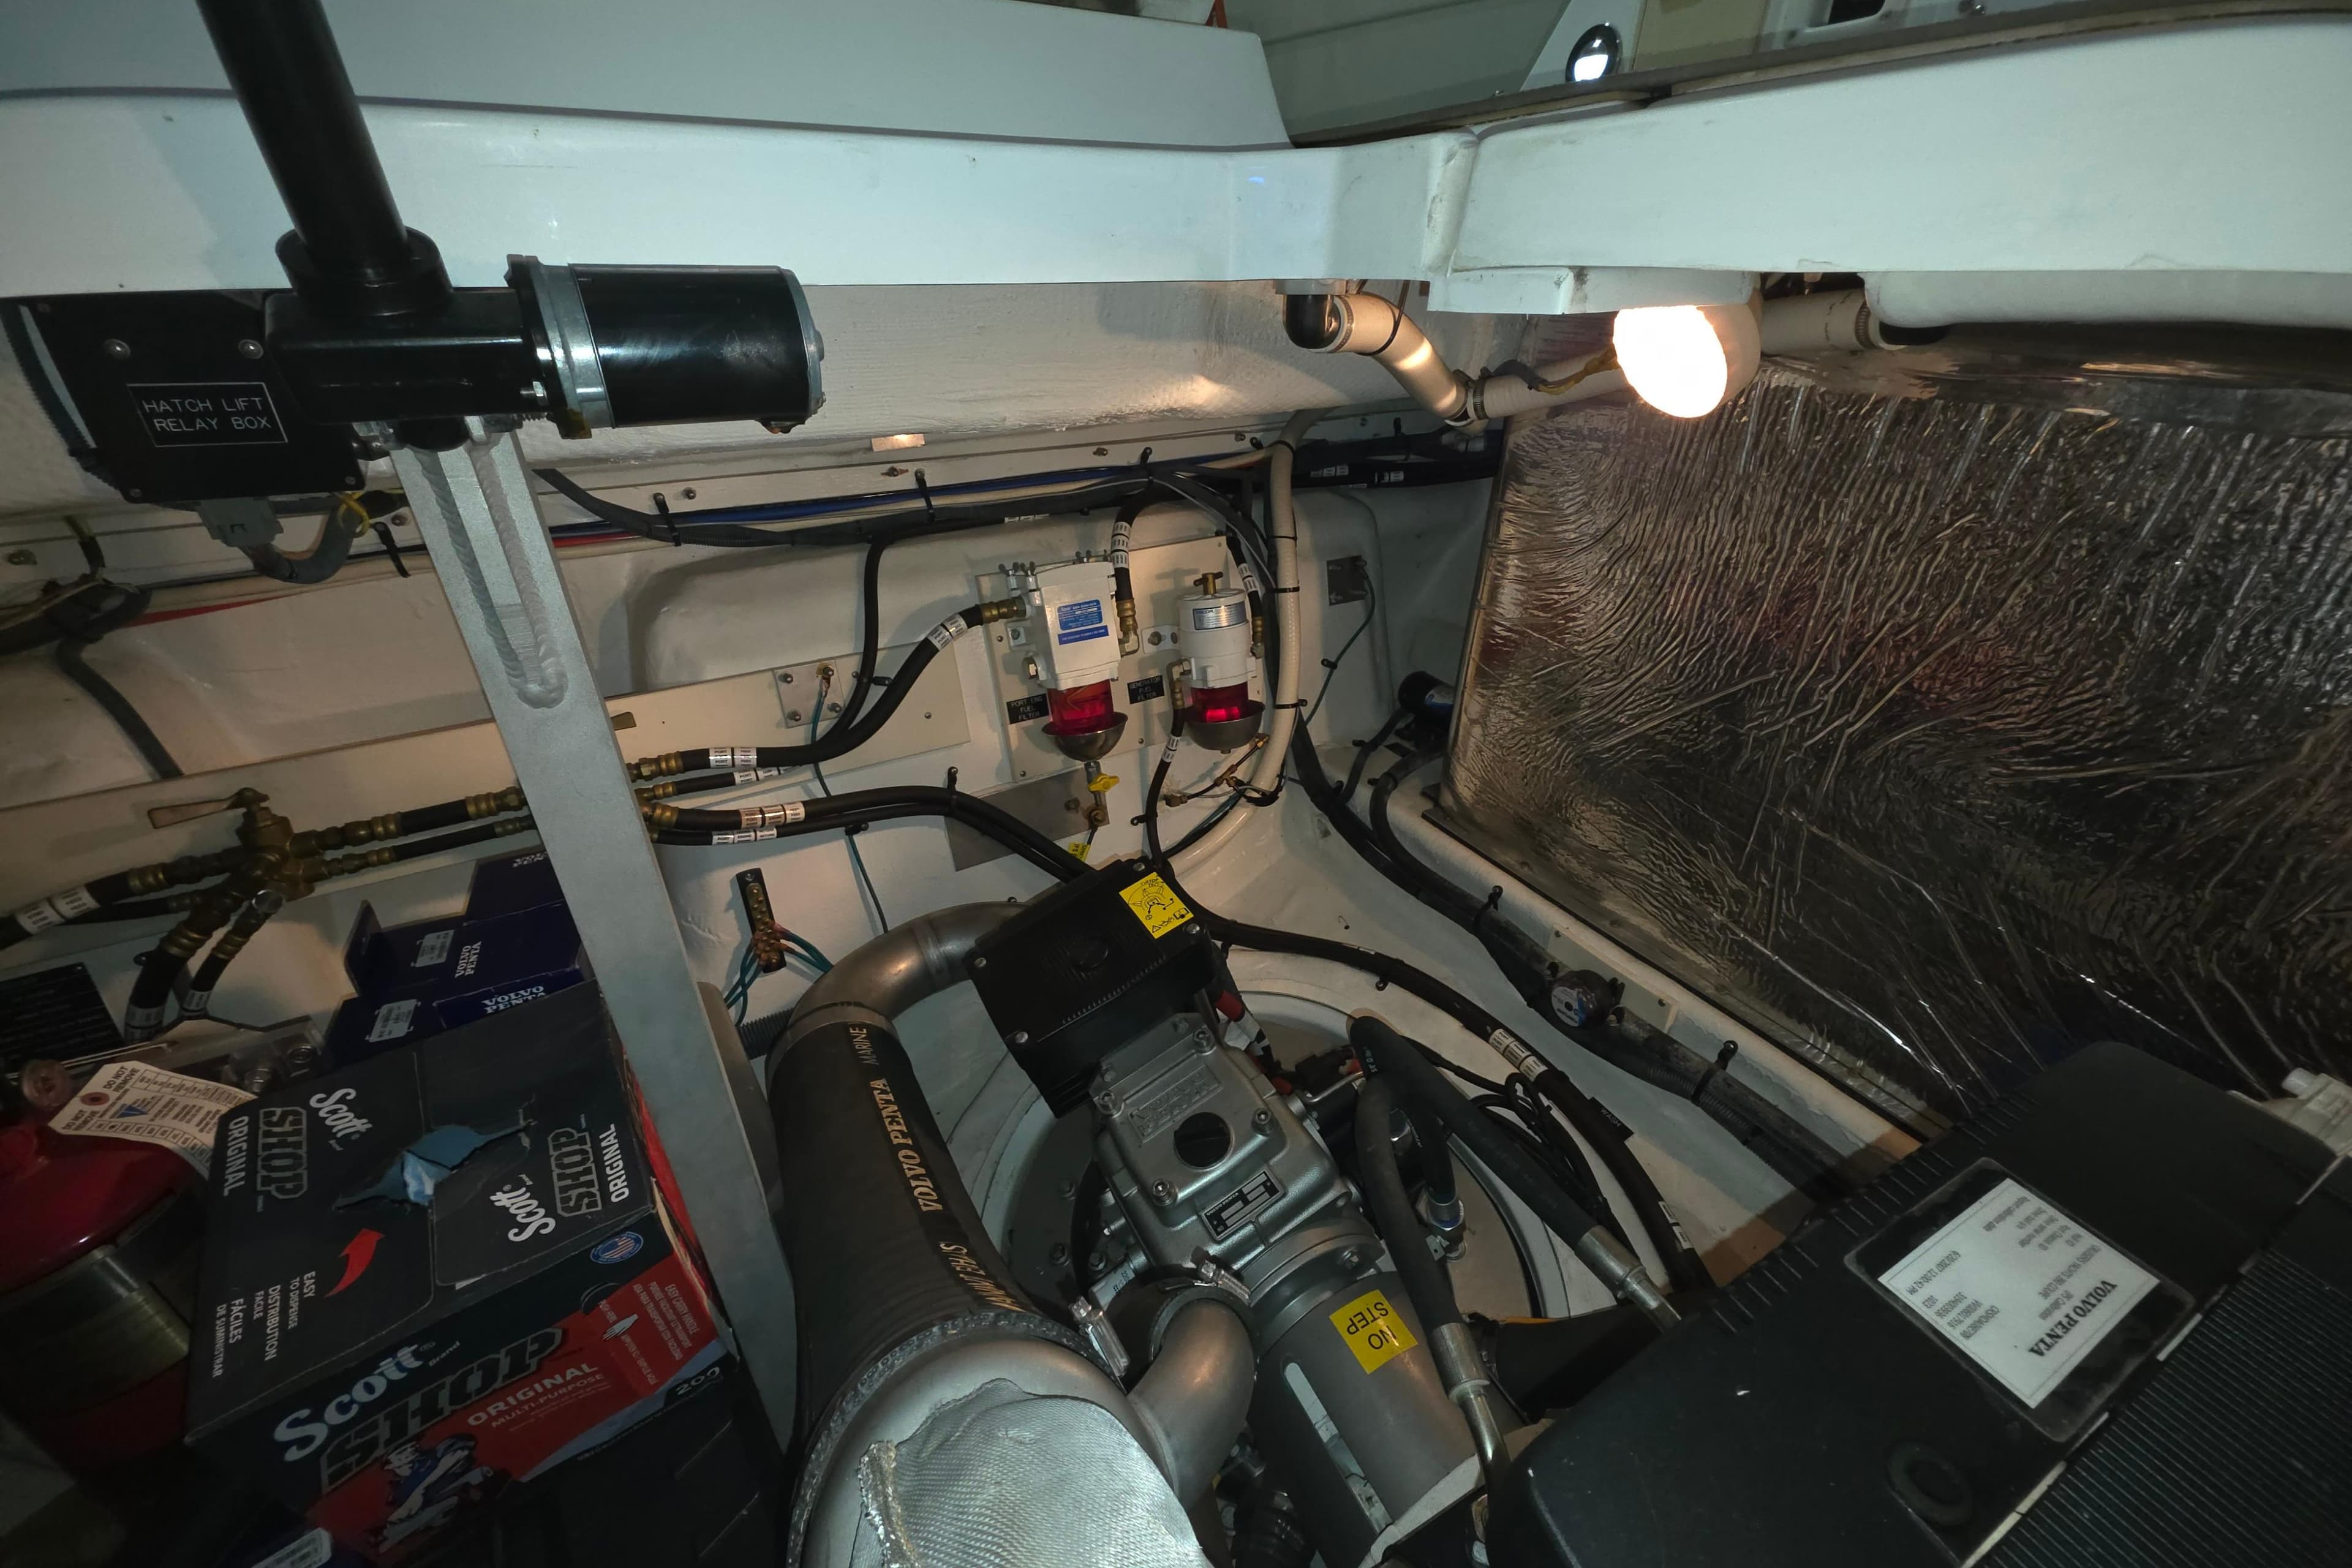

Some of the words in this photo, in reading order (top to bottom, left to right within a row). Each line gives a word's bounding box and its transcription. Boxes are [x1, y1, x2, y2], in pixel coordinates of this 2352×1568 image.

[143, 399, 213, 413] HATCH
[225, 397, 263, 411] LIFT
[154, 418, 218, 432] RELAY
[233, 417, 272, 431] BOX
[1011, 698, 1028, 707] PORT
[455, 945, 472, 978] VOLVO
[465, 941, 482, 976] PENTA
[481, 986, 545, 1006] VOLVO
[850, 1027, 880, 1066] MARINE
[104, 1077, 115, 1089] DO
[114, 1066, 129, 1081] NOT
[113, 1068, 140, 1092] REMOVE
[62, 1120, 74, 1129] DO
[72, 1109, 89, 1121] NOT
[74, 1110, 100, 1131] REMOVE
[309, 1088, 372, 1139] Scott
[870, 1078, 913, 1145] PENTA
[223, 1116, 249, 1196] ORIGINAL
[256, 1106, 309, 1199] SHOP
[597, 1123, 630, 1204] ORIGINAL
[549, 1127, 597, 1217] SHOP
[898, 1149, 943, 1212] VOLVO
[489, 1185, 555, 1242] Scott
[290, 1276, 299, 1291] TO
[302, 1269, 315, 1301] EASY
[1905, 1284, 1918, 1295] PM
[2071, 1278, 2115, 1317] VOLVO
[216, 1302, 226, 1319] DE
[253, 1289, 263, 1321] FACILE
[264, 1283, 280, 1363] DISTRIBUTION
[288, 1288, 299, 1330] DISPENSE
[1346, 1302, 1389, 1335] STEP
[212, 1316, 227, 1379] SUMINISTRAR
[1368, 1325, 1397, 1350] NO
[2029, 1314, 2078, 1359] PENTA
[467, 1363, 599, 1427] ORIGINAL
[674, 1366, 721, 1396] 200
[273, 1343, 429, 1462] Scott
[320, 1328, 562, 1492] SHOP
[490, 1373, 606, 1429] MULTI-PURPOSE
